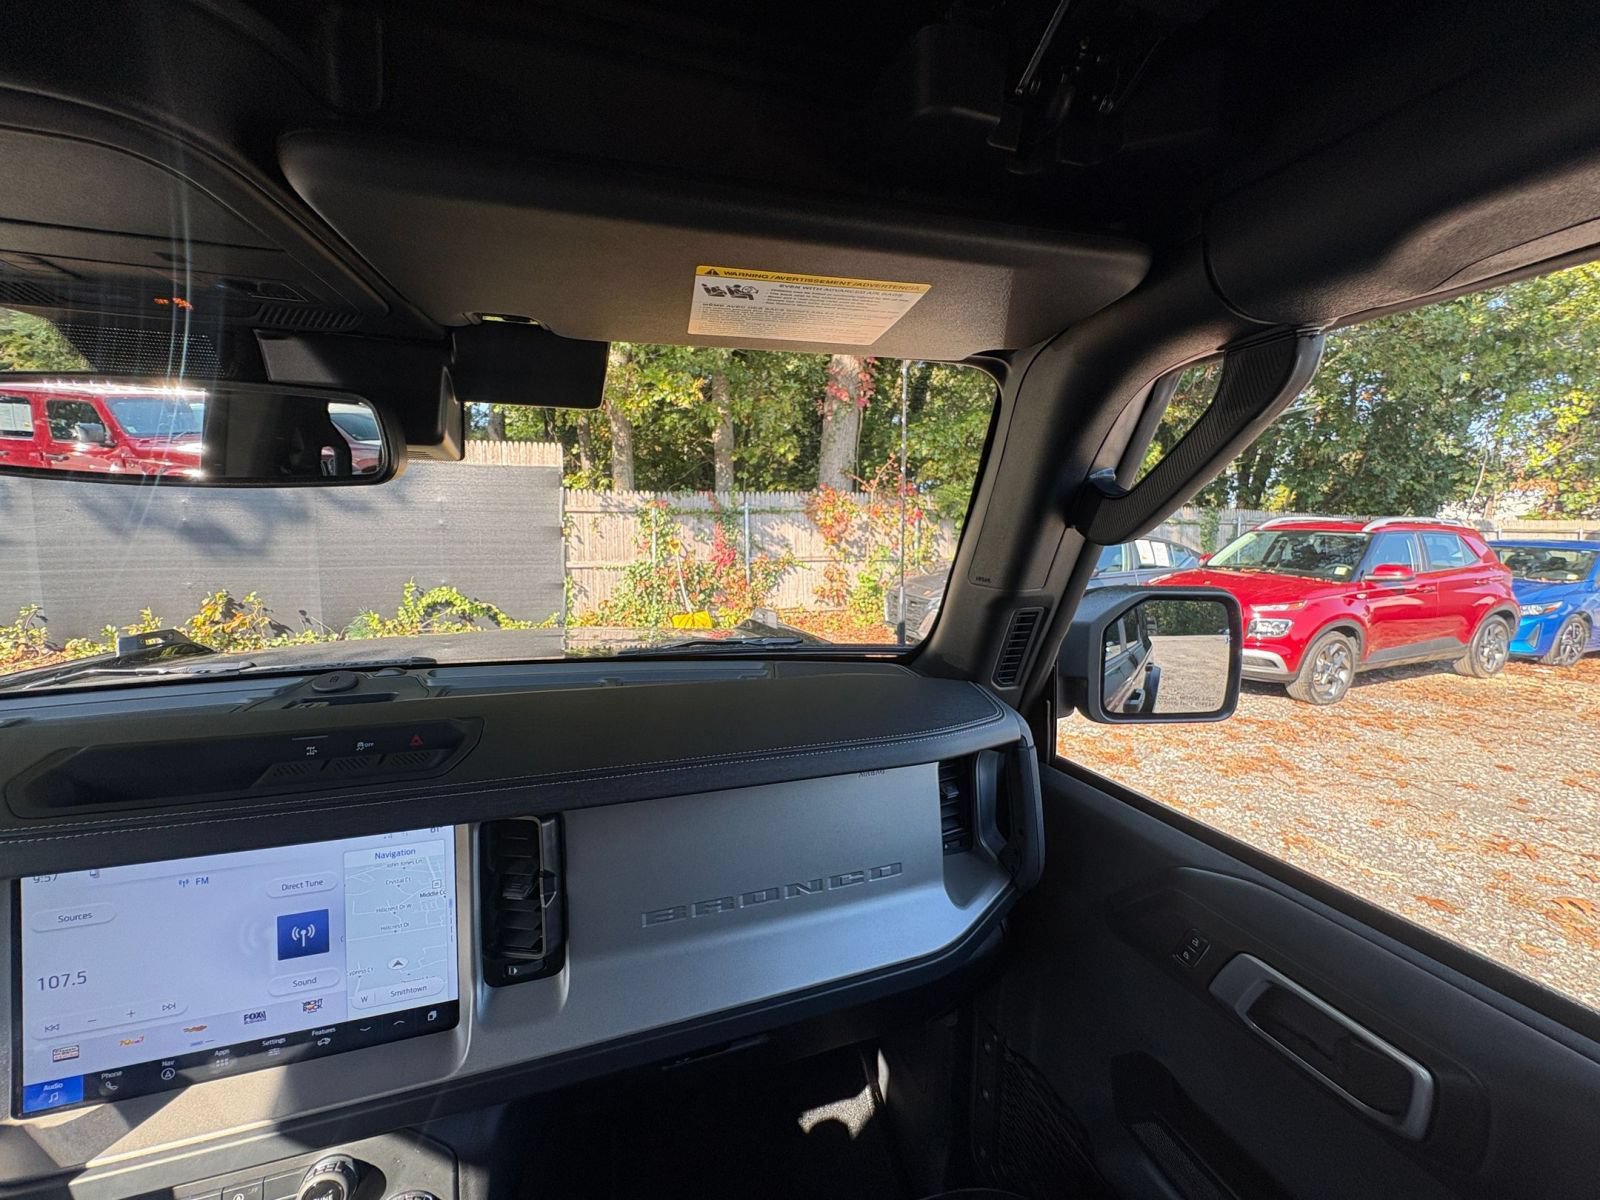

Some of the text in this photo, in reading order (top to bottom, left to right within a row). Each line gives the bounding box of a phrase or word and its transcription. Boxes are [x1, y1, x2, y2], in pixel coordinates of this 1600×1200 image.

[723, 270, 769, 279] WARNING
[374, 848, 416, 860] Navigation
[195, 876, 209, 885] FM
[281, 879, 324, 892] Direct Tune
[641, 862, 903, 928] BRONCO
[57, 911, 93, 923] Sources
[37, 970, 88, 991] 107.5
[292, 977, 317, 988] Sound
[360, 985, 428, 1003] W Smithtown
[311, 1027, 337, 1037] Features
[261, 1037, 287, 1047] Settings
[214, 1049, 231, 1057] Apps
[101, 1071, 123, 1080] Phone
[43, 1083, 64, 1091] Audio
